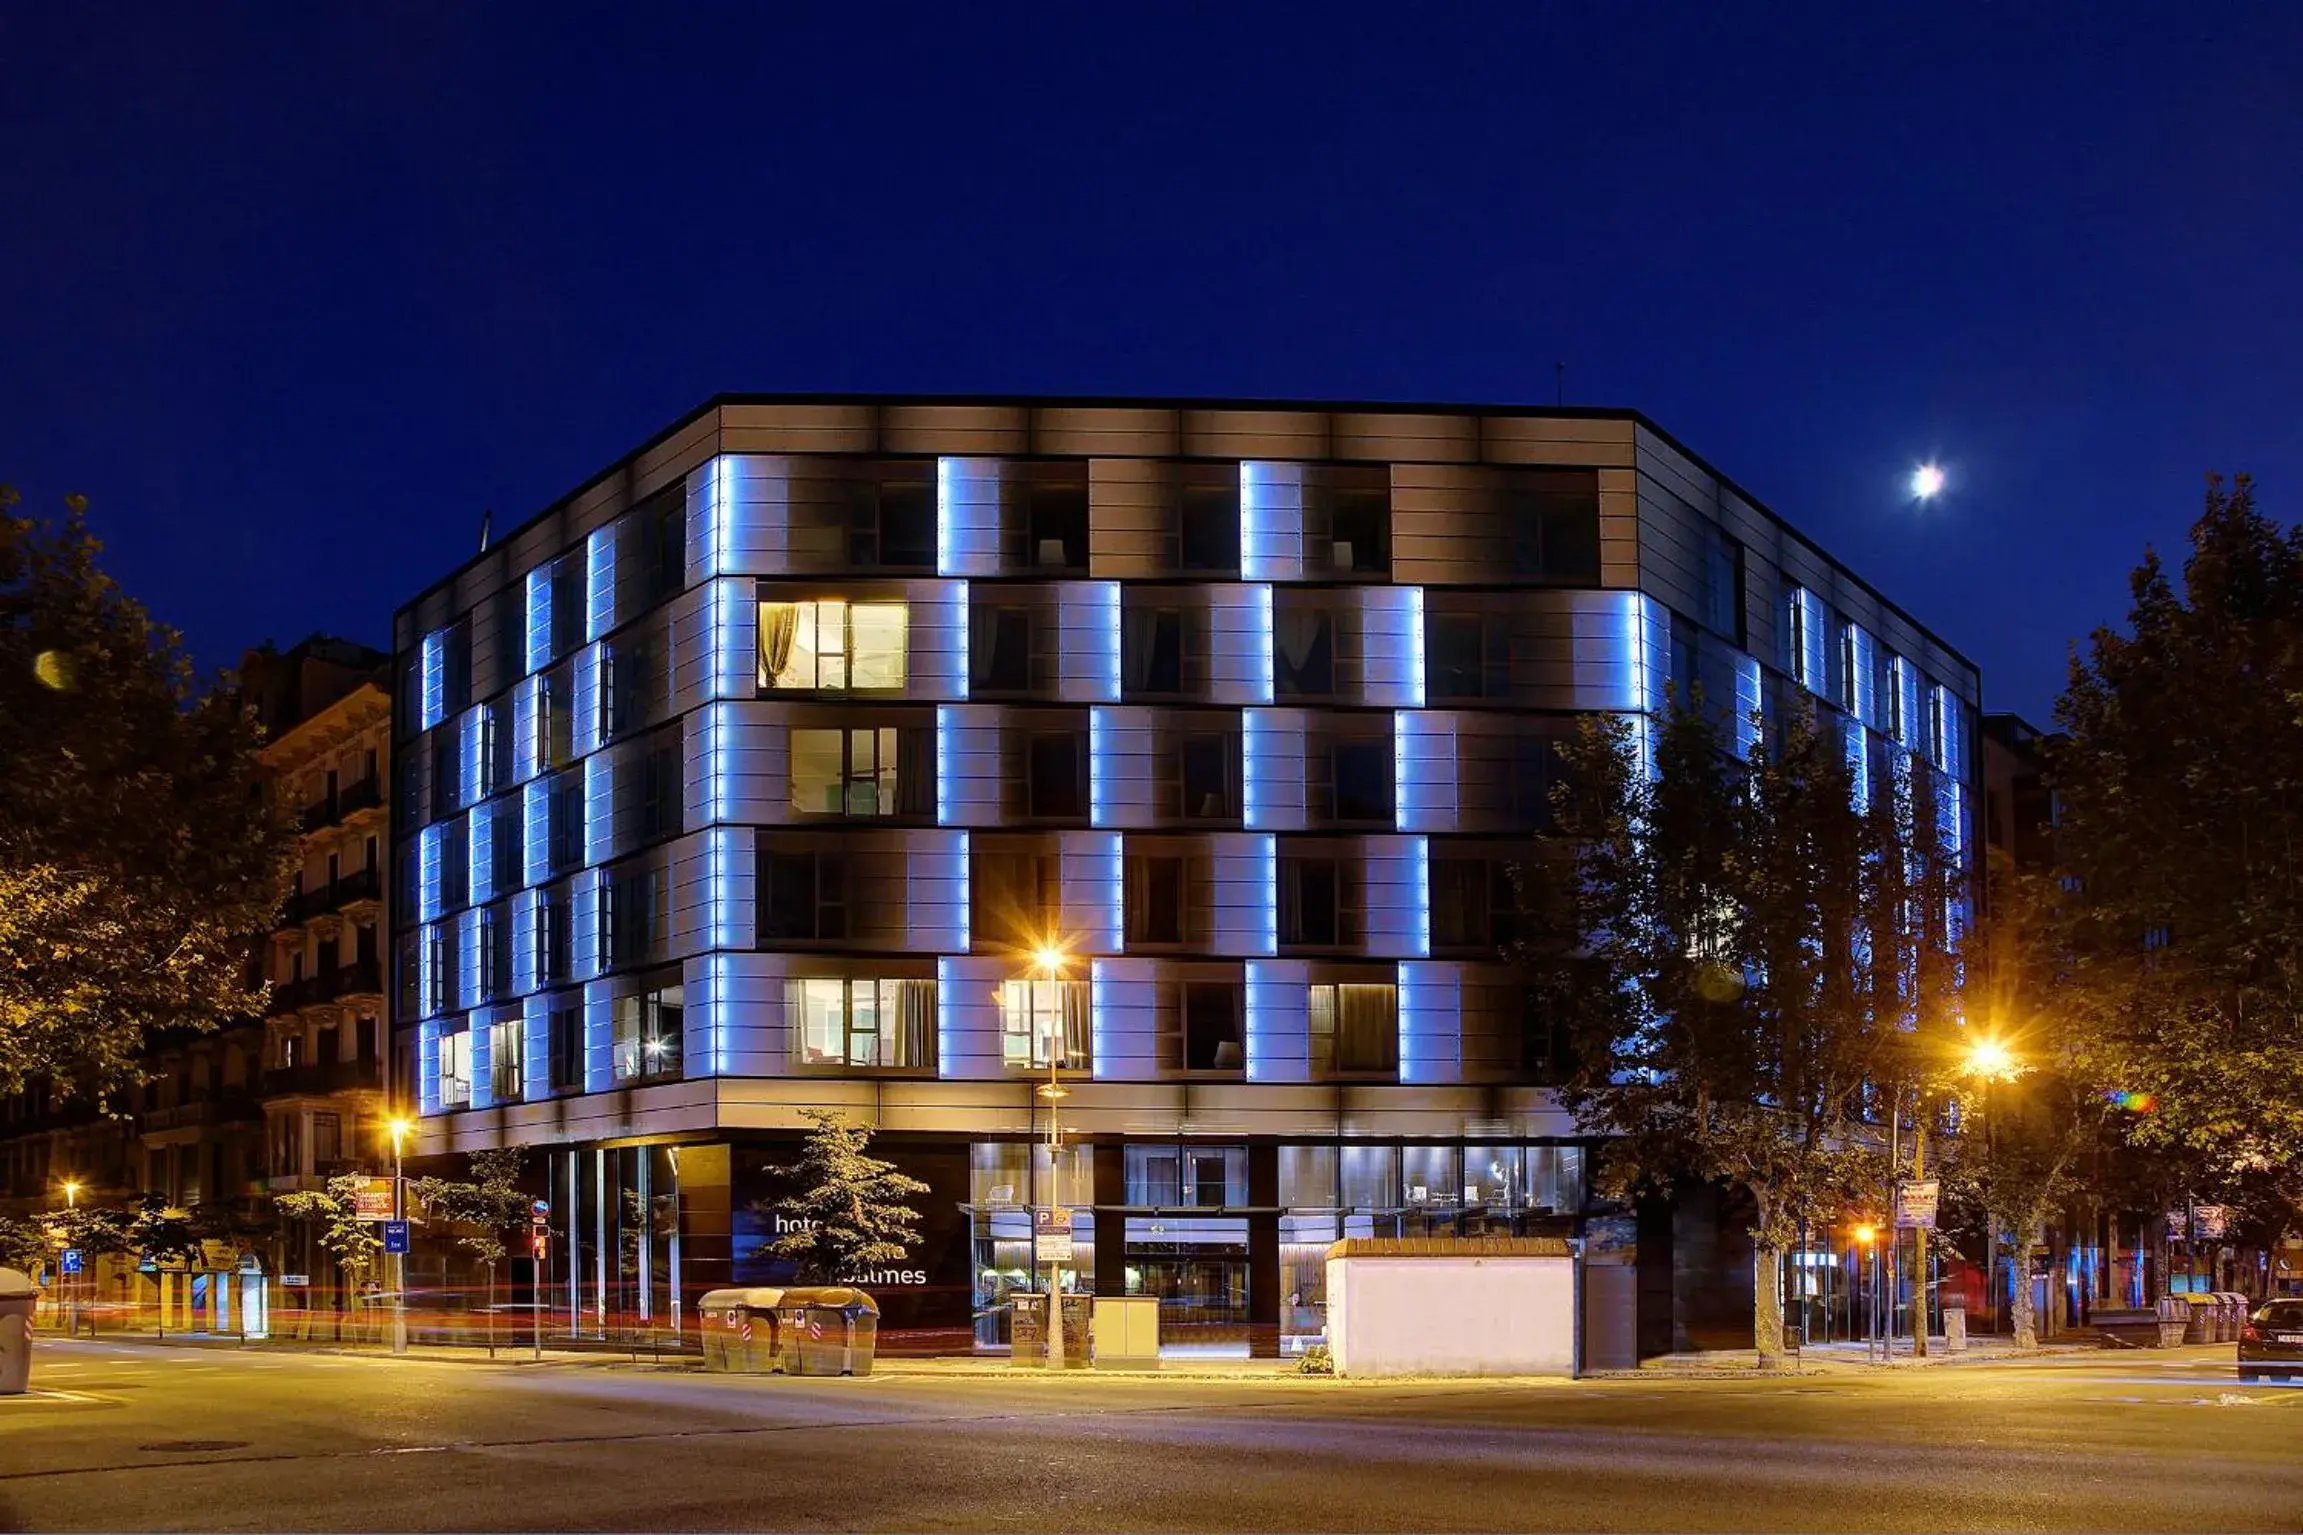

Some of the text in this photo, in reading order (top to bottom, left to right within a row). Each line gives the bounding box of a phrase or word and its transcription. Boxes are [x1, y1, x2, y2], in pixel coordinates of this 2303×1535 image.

[776, 1214, 824, 1233] hot
[1040, 1212, 1050, 1224] P
[66, 1252, 77, 1263] P
